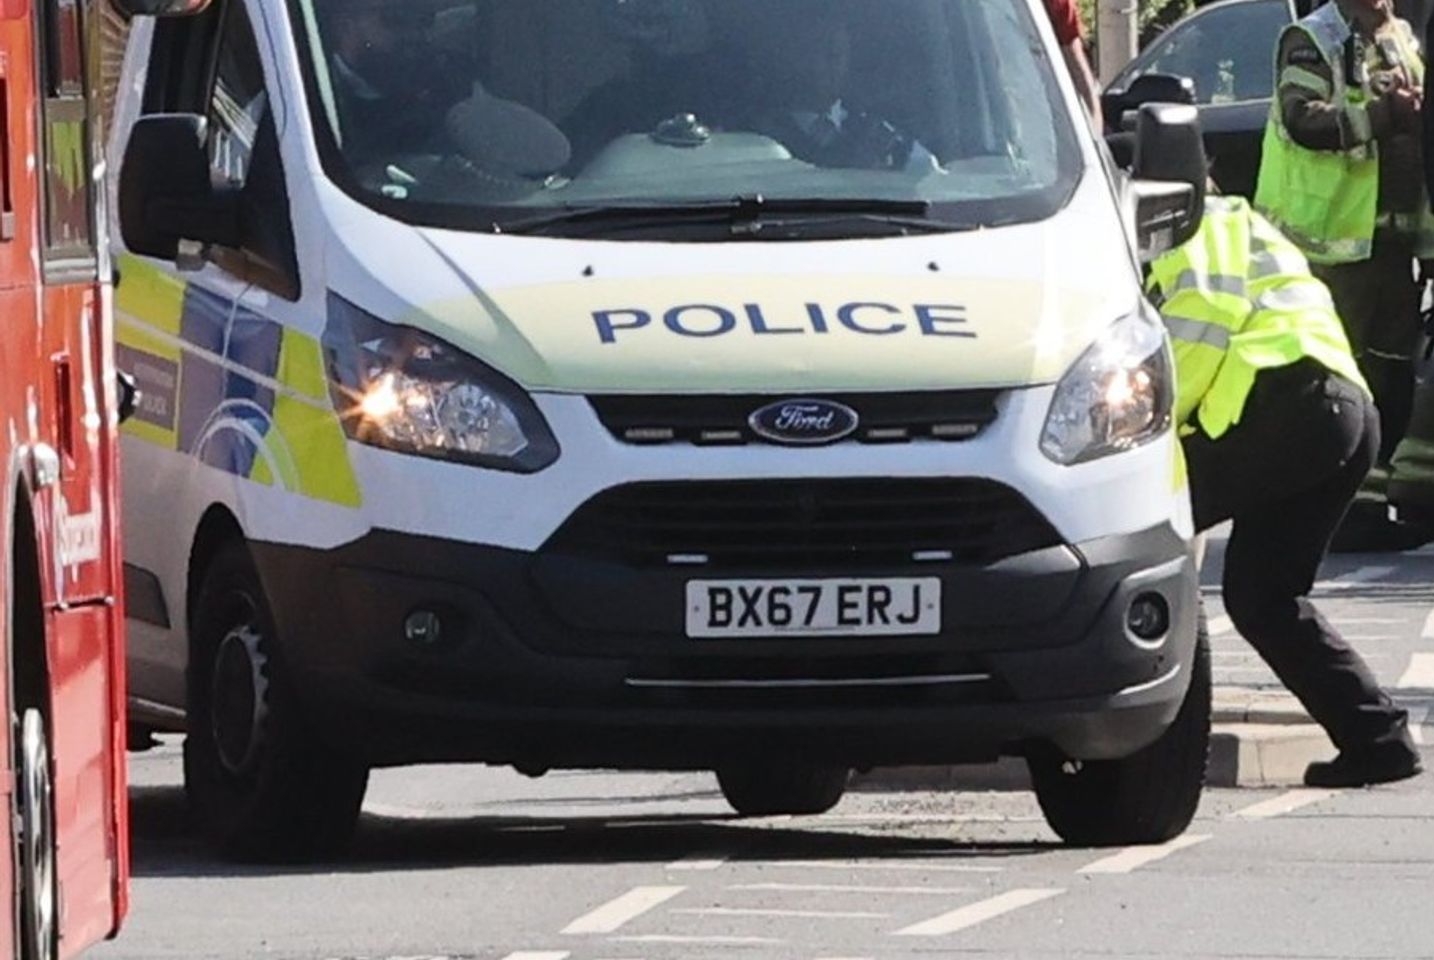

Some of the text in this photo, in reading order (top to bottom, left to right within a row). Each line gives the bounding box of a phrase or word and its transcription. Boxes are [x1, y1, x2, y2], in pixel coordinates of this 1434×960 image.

[592, 302, 978, 344] POLICE
[775, 405, 834, 430] Ford
[707, 584, 922, 628] BX67 ERJ
